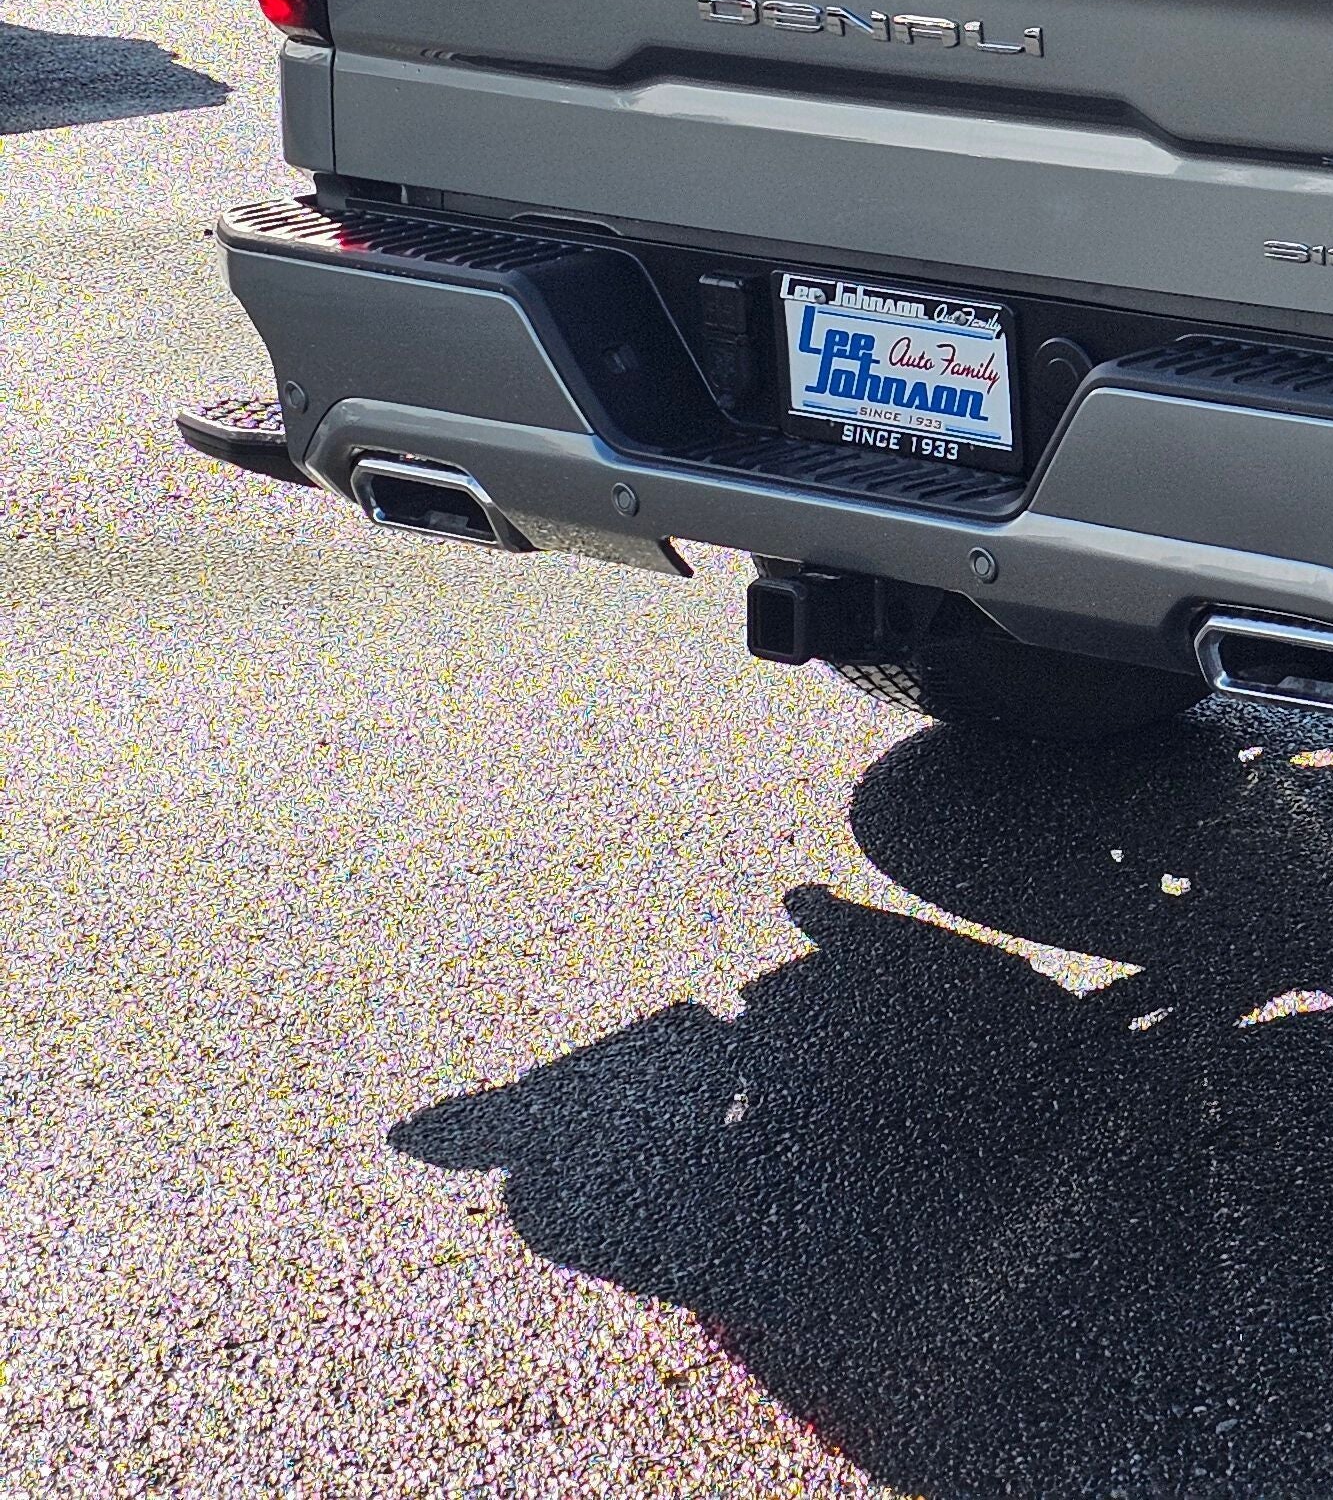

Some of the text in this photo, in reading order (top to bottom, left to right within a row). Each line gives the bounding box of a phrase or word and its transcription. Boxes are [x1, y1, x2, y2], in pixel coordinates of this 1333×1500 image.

[828, 281, 928, 320] Johnson
[798, 305, 1000, 395] Lee Auto Family
[804, 352, 989, 422] Johnson
[859, 406, 942, 430] SINCE 1933
[841, 424, 959, 460] SINCE 1933
